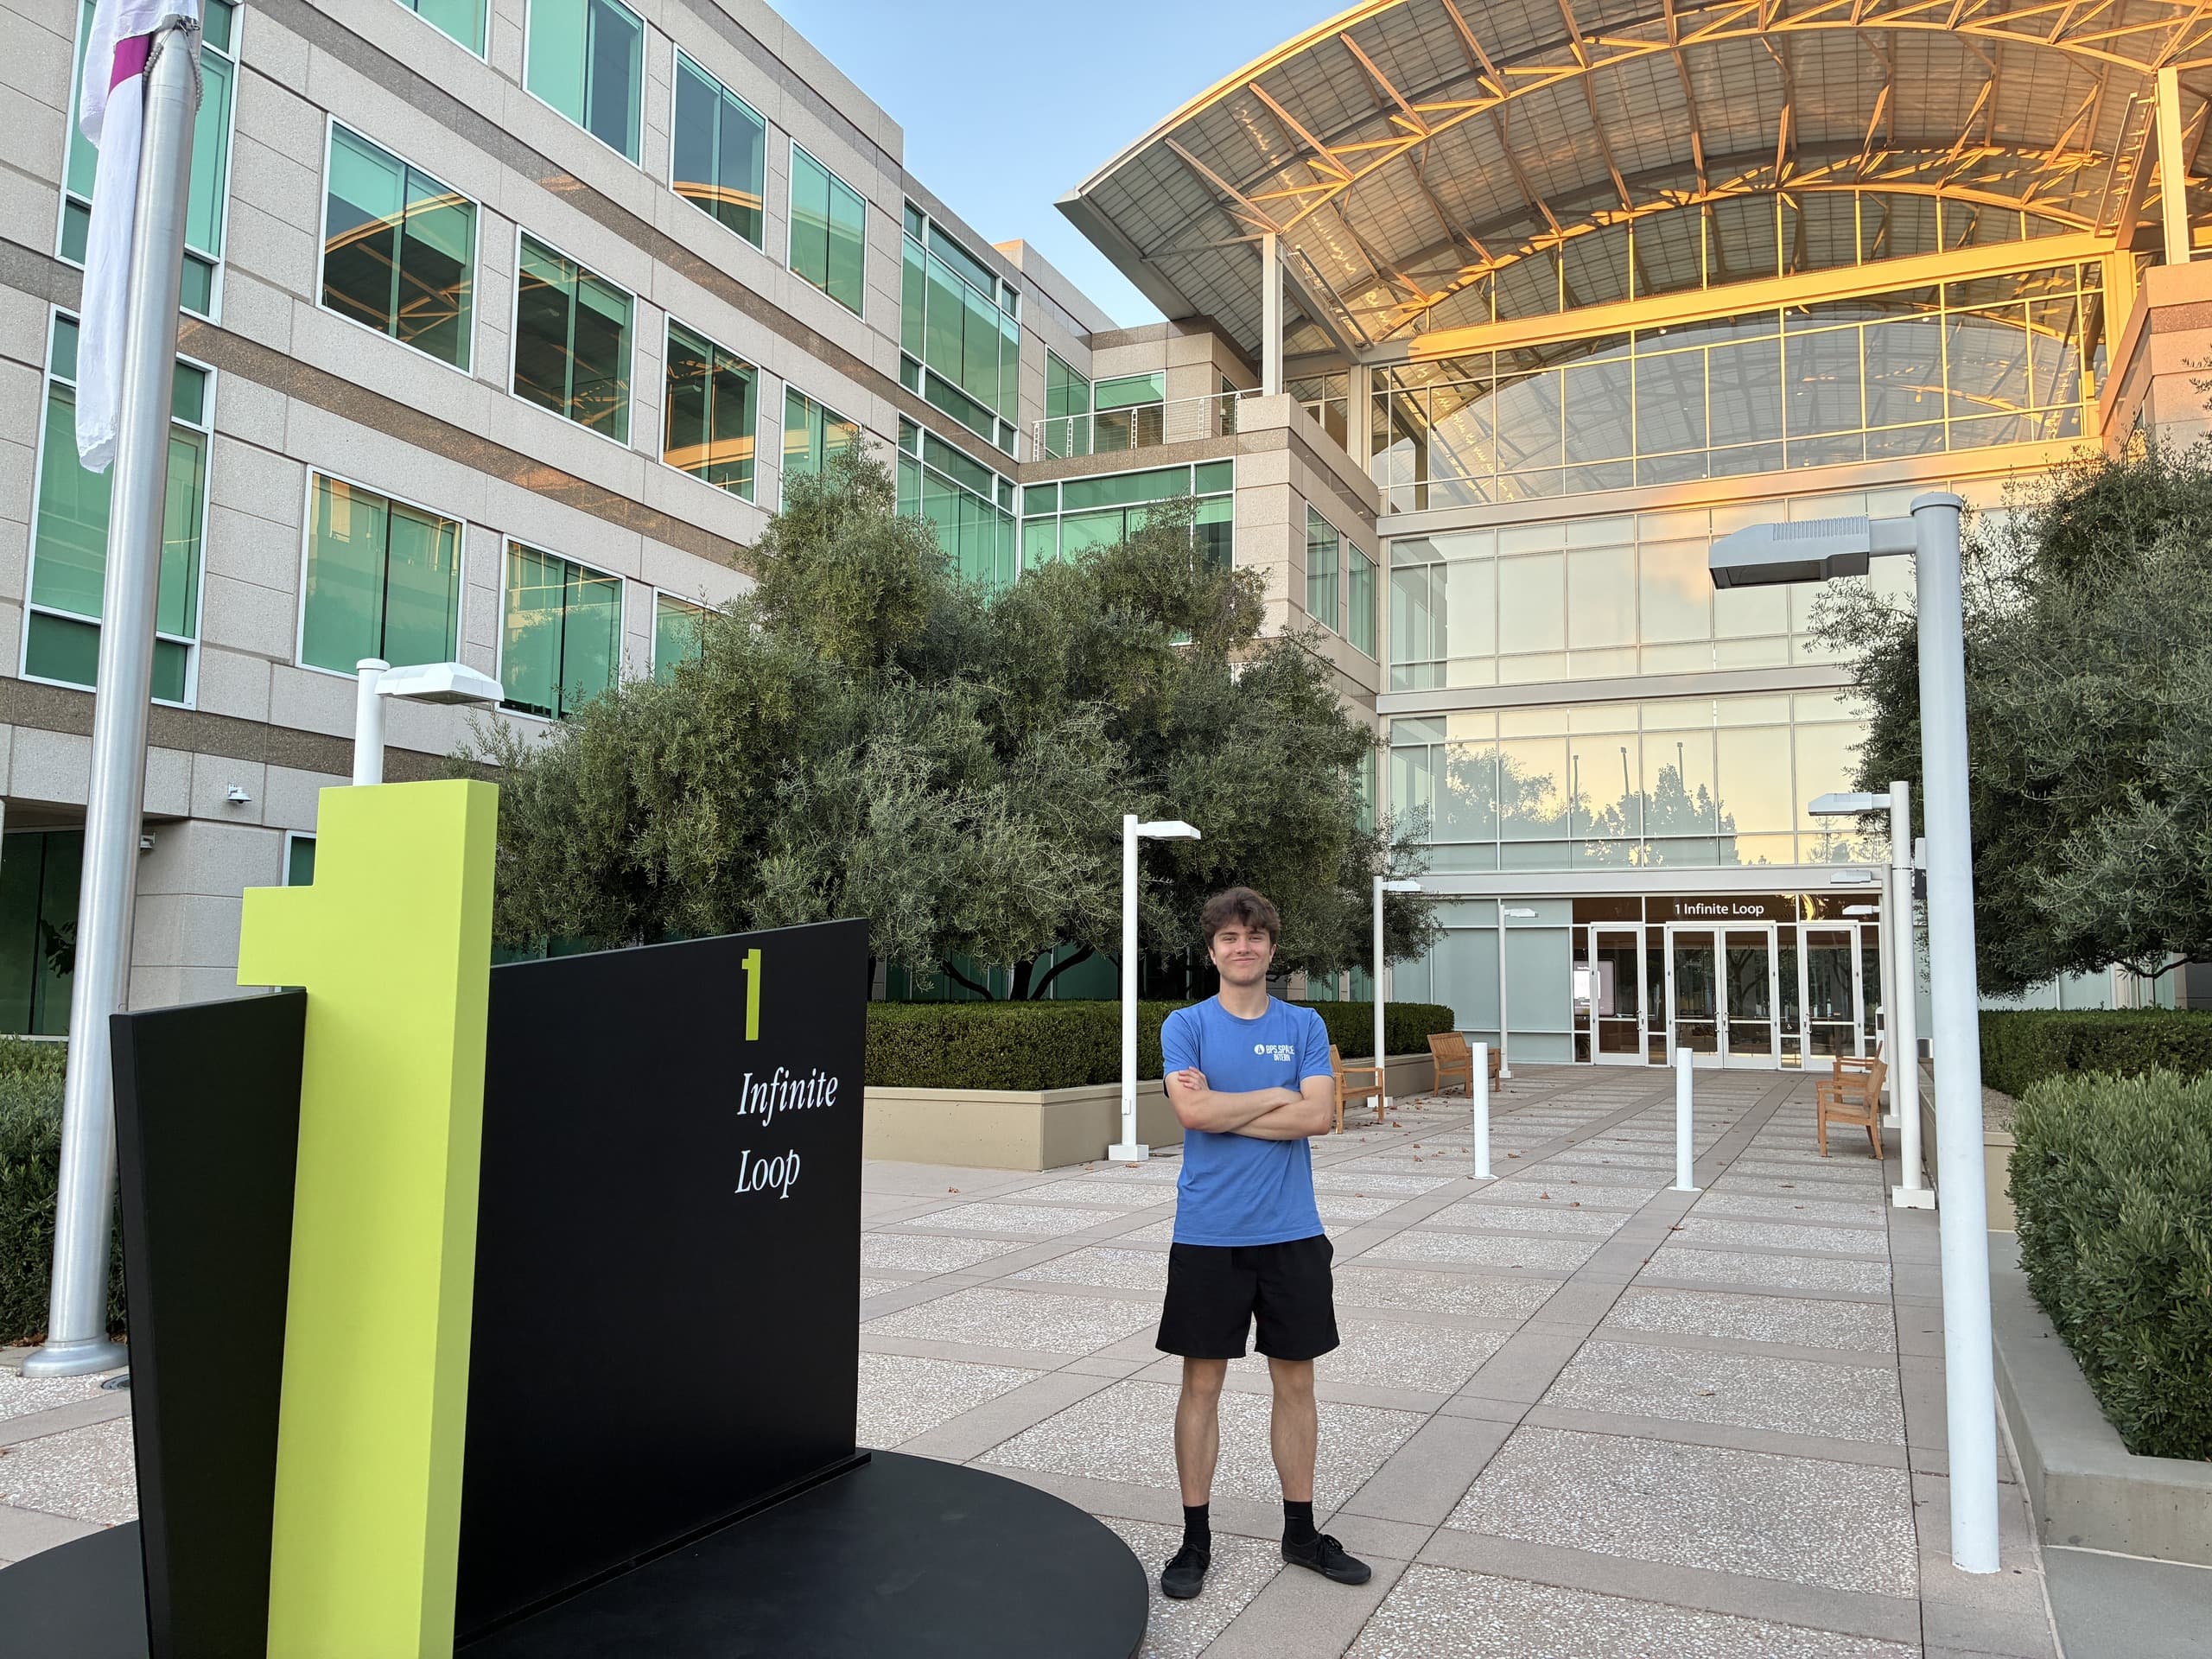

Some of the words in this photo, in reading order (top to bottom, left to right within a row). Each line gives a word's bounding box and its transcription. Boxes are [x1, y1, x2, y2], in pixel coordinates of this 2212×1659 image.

[1675, 903, 1681, 915] 1
[1684, 902, 1729, 915] Infinite
[1732, 902, 1764, 918] Loop
[741, 949, 761, 1040] 1
[736, 1066, 838, 1128] Infinite
[734, 1148, 800, 1199] Loop
